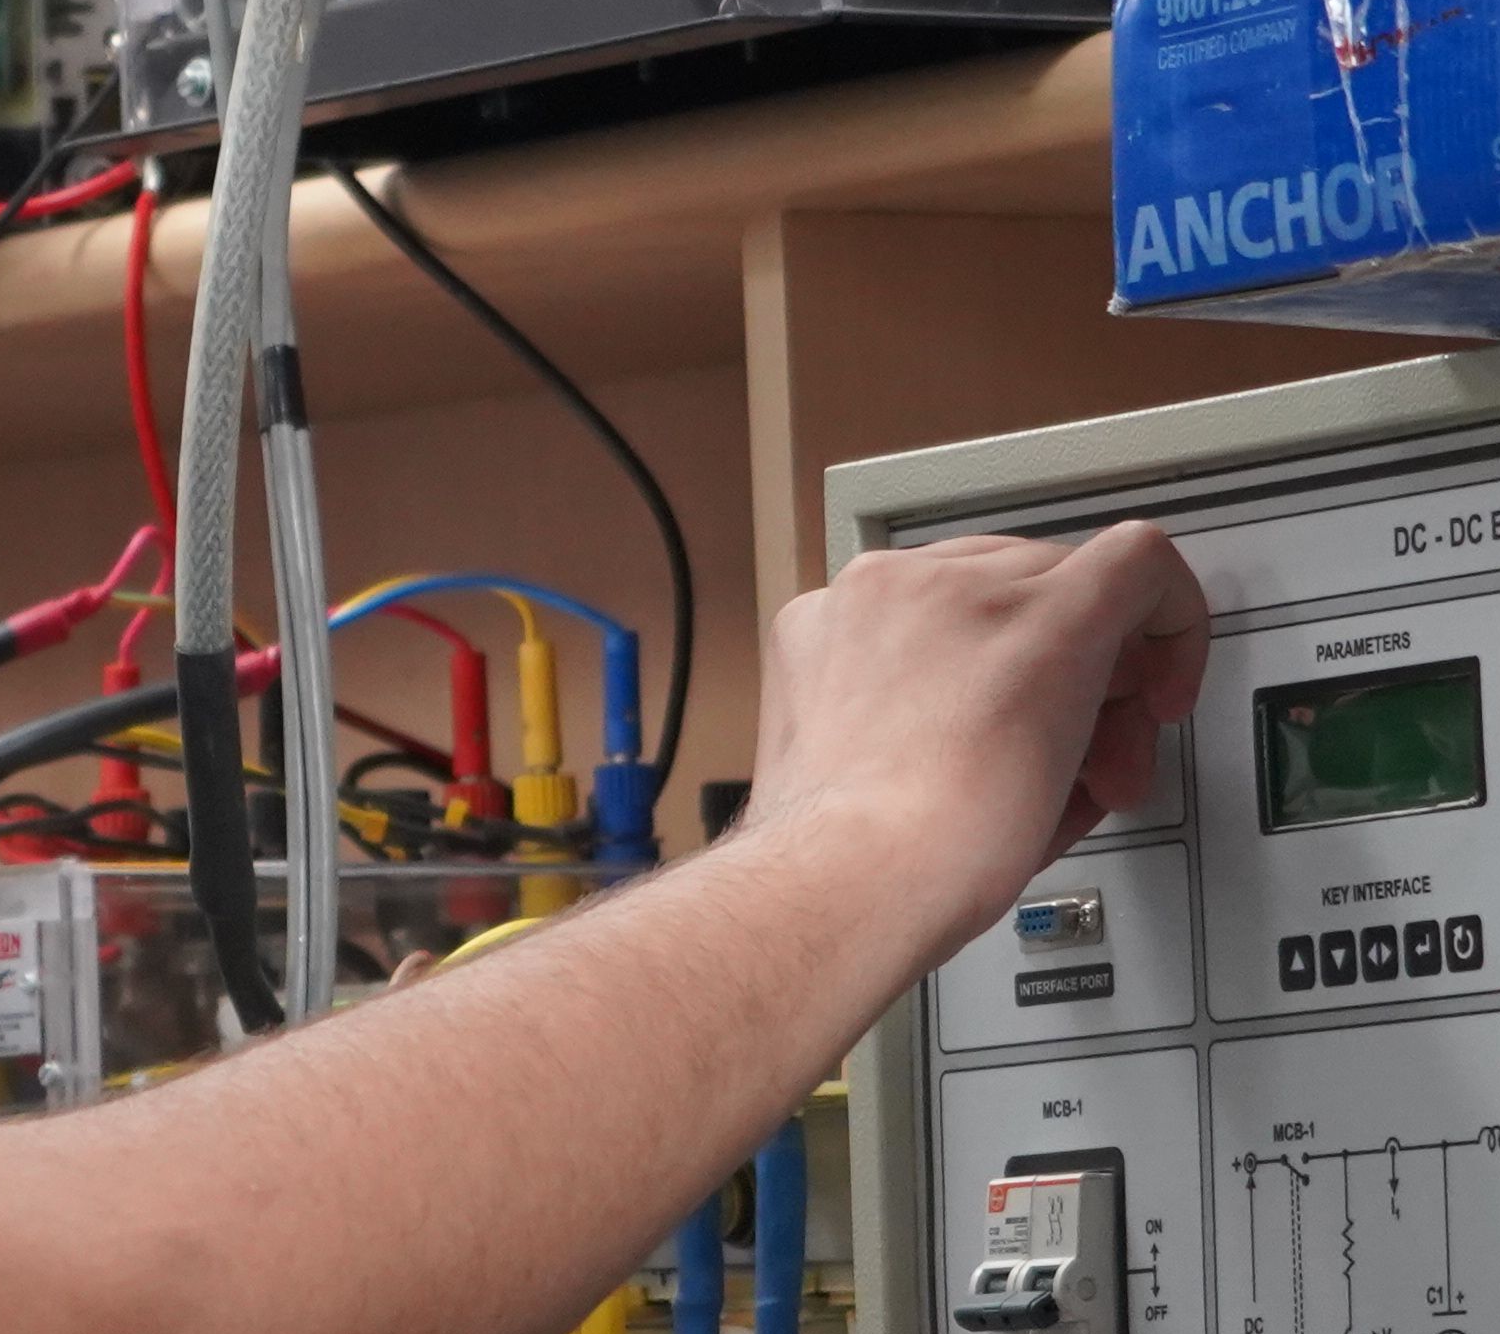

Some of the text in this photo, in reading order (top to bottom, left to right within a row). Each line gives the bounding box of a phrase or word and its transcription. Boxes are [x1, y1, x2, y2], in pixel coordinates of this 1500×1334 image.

[1158, 35, 1226, 69] CERTIFIED
[1230, 19, 1297, 54] COMPANY
[1127, 152, 1424, 283] ANCHOR
[1394, 522, 1426, 557] DC
[1450, 514, 1483, 548] DC
[1316, 632, 1411, 662] PARAMETERS
[1321, 875, 1431, 908] KEY INTERFACE
[1018, 972, 1109, 998] INTERFACE PORT
[1042, 1099, 1083, 1119] MCB-1
[1272, 1121, 1315, 1142] MCB-1
[1145, 1219, 1162, 1235] ON
[1427, 1287, 1443, 1304] C1
[1145, 1304, 1168, 1321] OFF
[1244, 1317, 1264, 1334] DC
